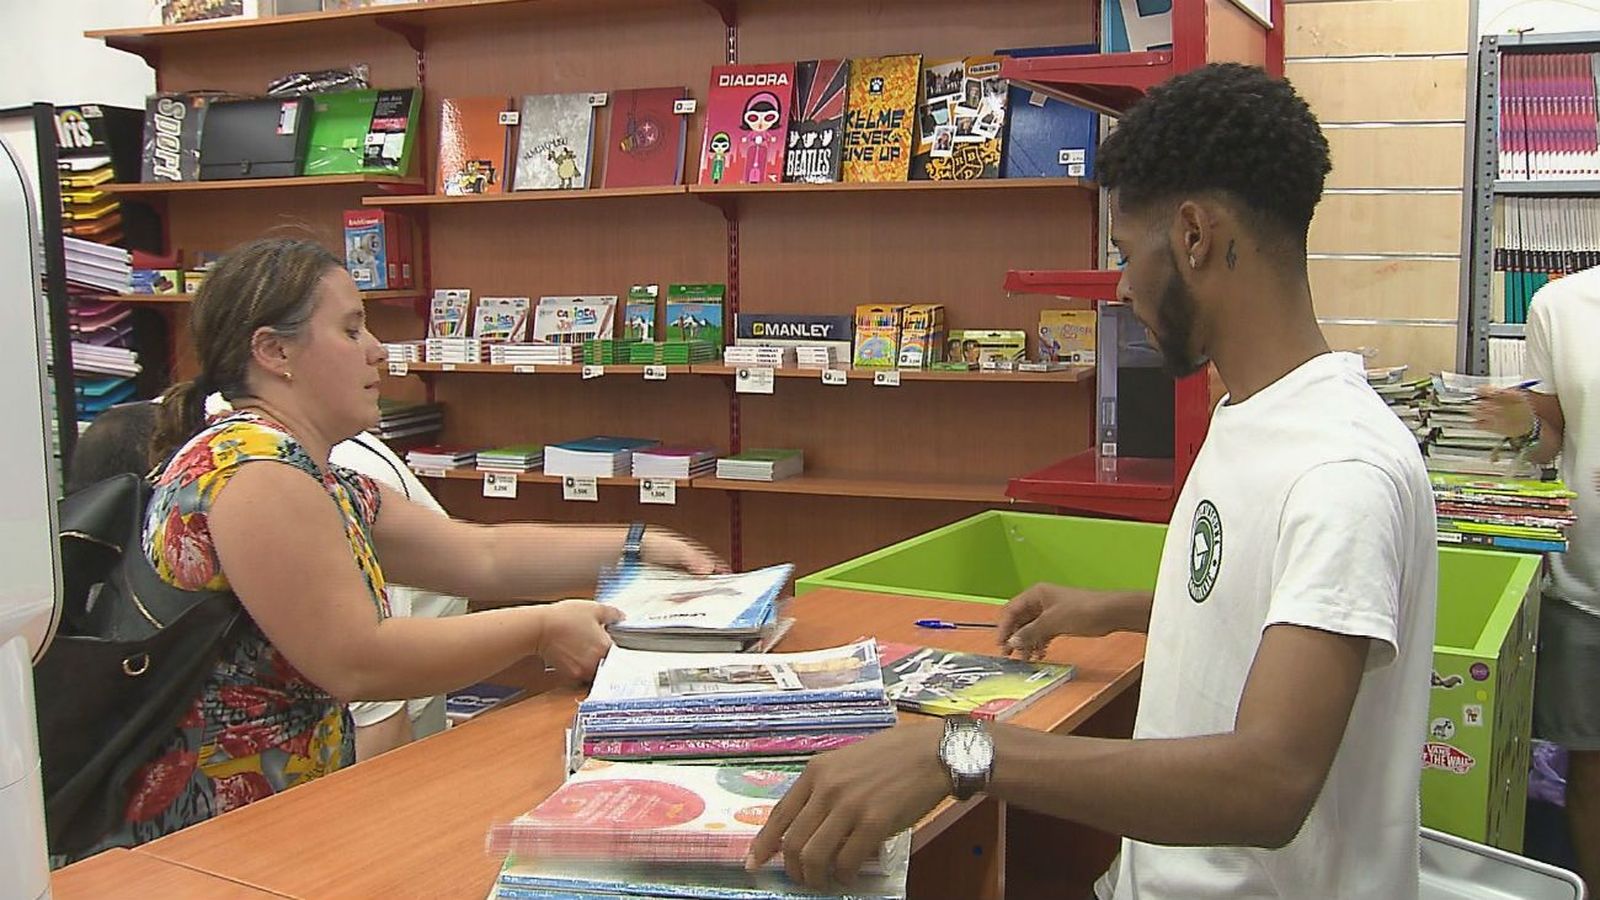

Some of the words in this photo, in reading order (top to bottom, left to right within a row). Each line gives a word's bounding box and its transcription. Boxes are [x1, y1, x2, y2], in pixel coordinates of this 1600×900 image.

[719, 74, 788, 86] DIADORA
[847, 110, 905, 129] KELME
[153, 98, 185, 181] Sport
[786, 148, 831, 176] BEATLES
[880, 147, 901, 161] UP
[765, 323, 830, 337] MANLEY
